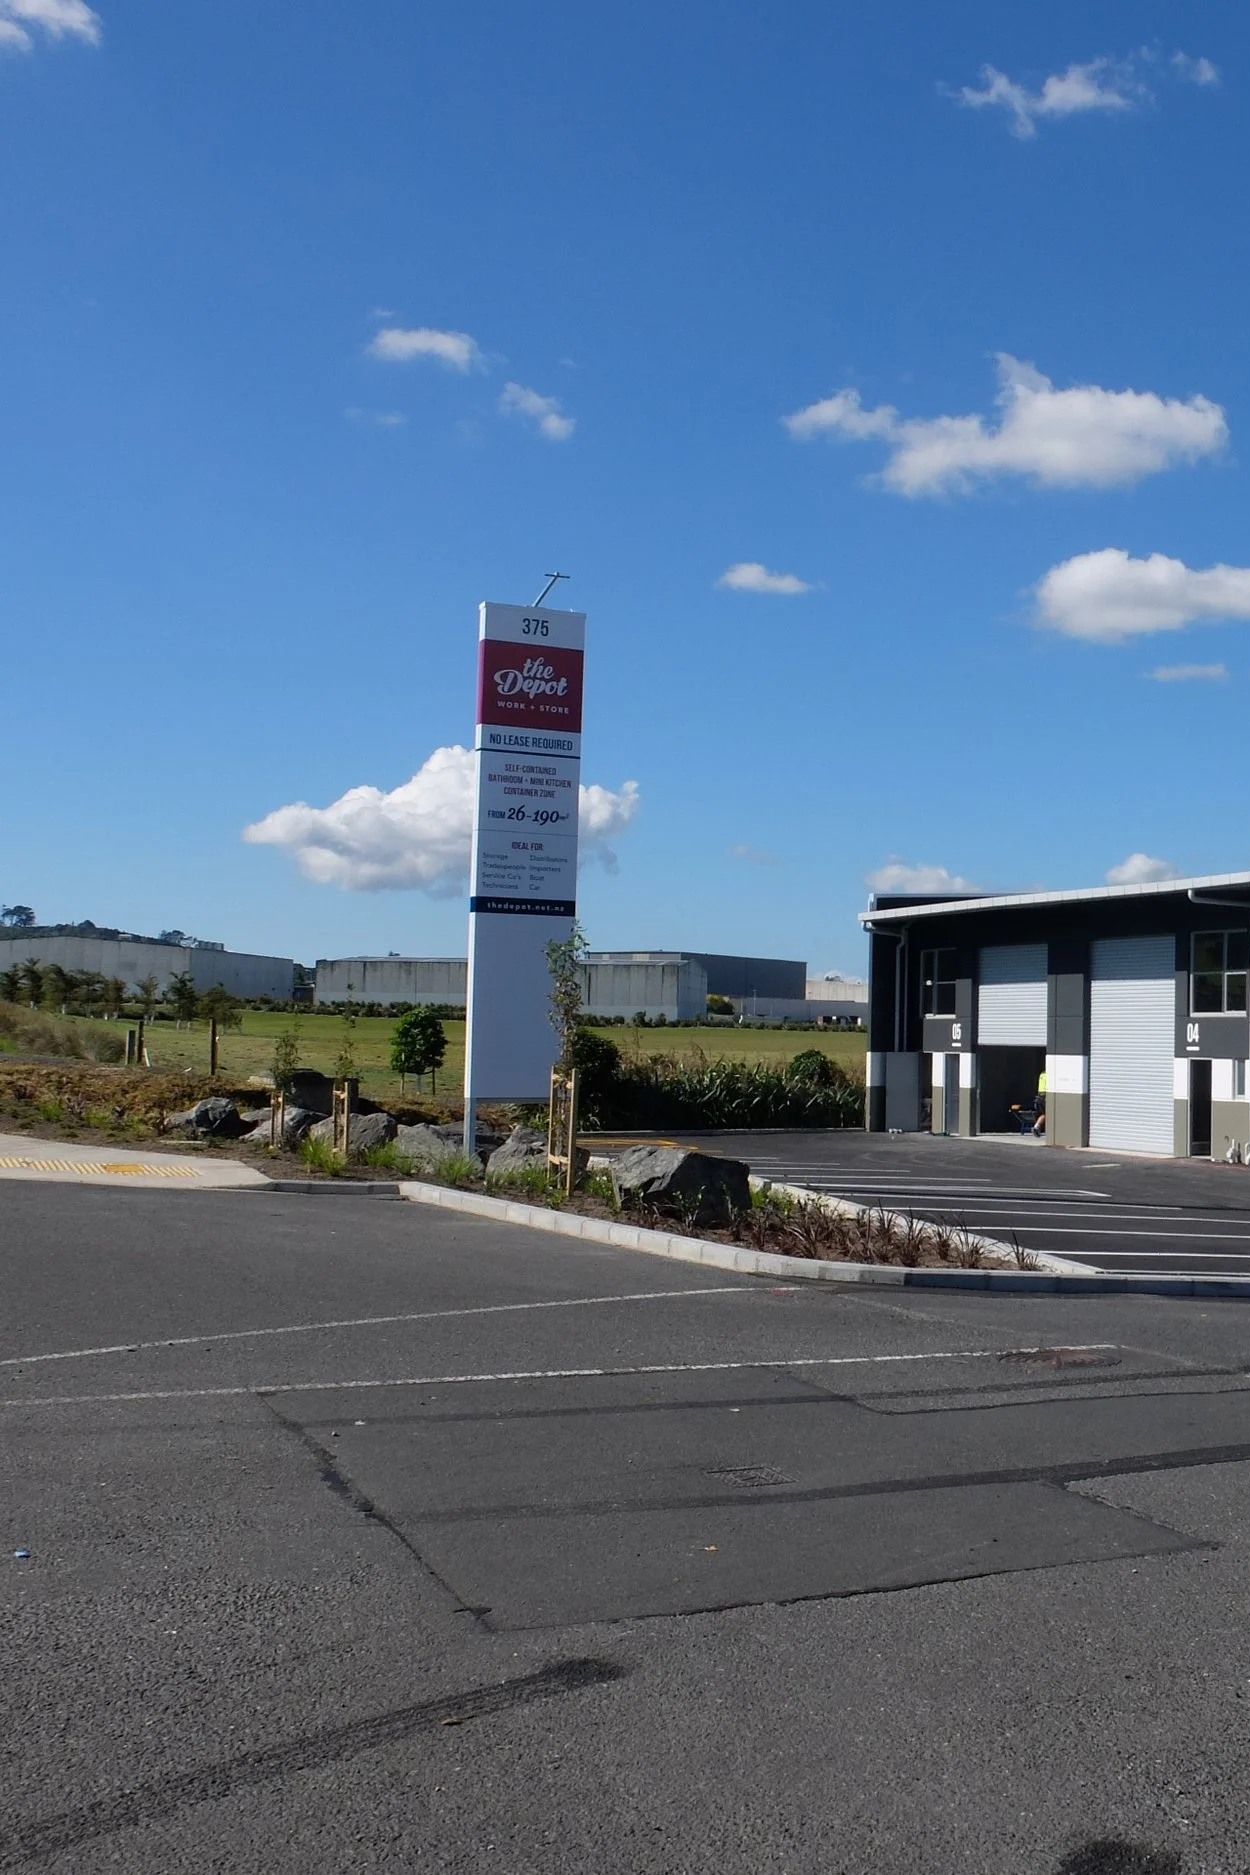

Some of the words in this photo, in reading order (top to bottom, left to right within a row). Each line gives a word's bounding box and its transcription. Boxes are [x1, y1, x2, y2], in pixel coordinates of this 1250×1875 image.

[522, 618, 549, 637] 375
[523, 657, 555, 680] the
[494, 669, 568, 700] Depot
[497, 701, 526, 710] WORK
[540, 705, 569, 714] STORE
[489, 733, 502, 745] NO
[503, 735, 530, 748] LEASE
[532, 737, 573, 751] REQUIRED
[488, 773, 524, 785] BATHROOM
[530, 777, 544, 787] MINI
[545, 778, 572, 789] KITCHEN
[503, 787, 539, 798] CONTAINER
[540, 789, 557, 799] ZONE
[488, 810, 506, 820] FROM
[511, 841, 529, 851] IDEAL
[482, 852, 509, 862] Storage
[530, 854, 568, 864] Distributors
[483, 862, 527, 872] Tradespeople
[530, 865, 561, 873] Importers
[481, 872, 506, 880] Service
[487, 902, 565, 912] thedepot.net.nz
[952, 1023, 962, 1040] 05
[1186, 1023, 1200, 1043] 04
